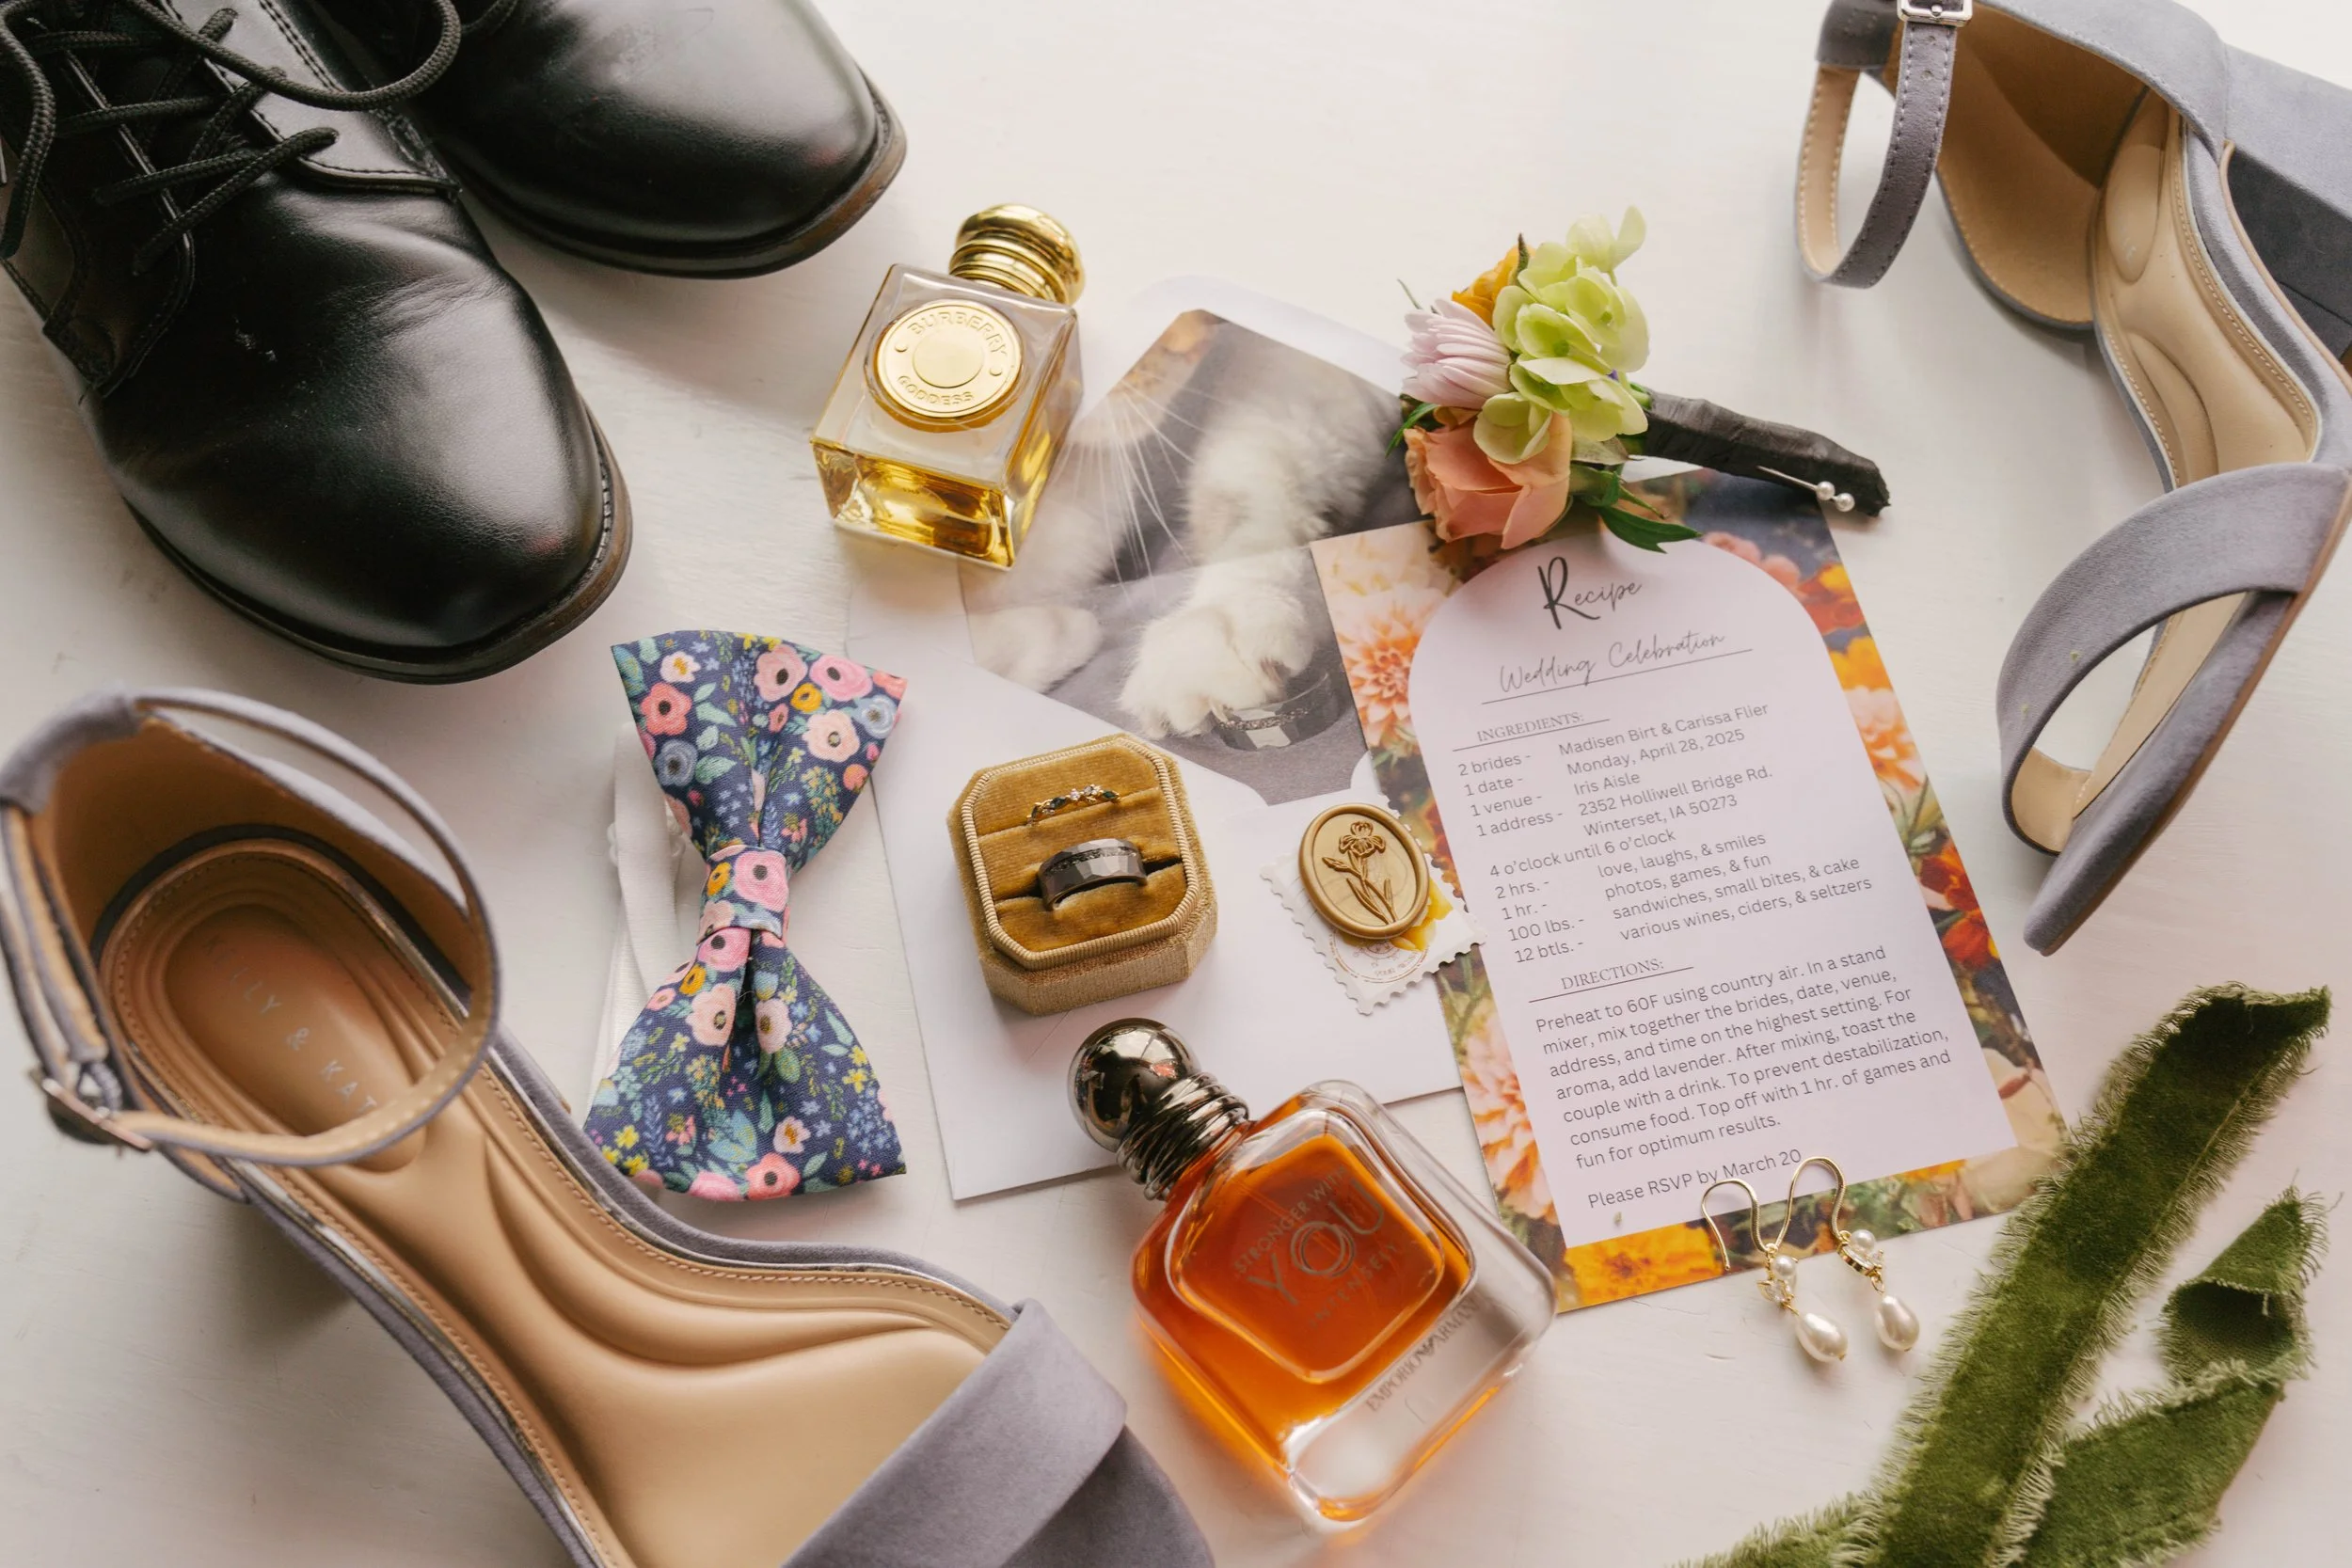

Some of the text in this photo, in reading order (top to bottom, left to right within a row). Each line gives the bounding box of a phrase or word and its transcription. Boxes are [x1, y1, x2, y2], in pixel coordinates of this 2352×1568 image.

[906, 310, 1009, 356] BURBERRY
[896, 374, 976, 406] GODDESS
[1536, 556, 1642, 630] Recipe
[1499, 629, 1725, 693] Wedding Celebration
[1457, 763, 1470, 777] 2
[1470, 754, 1522, 774] brides
[1558, 734, 1626, 755] Madisen
[1627, 726, 1659, 742] Birt
[1661, 722, 1674, 736] &
[1675, 712, 1734, 733] Carissa
[1733, 704, 1768, 721] Flier
[1476, 711, 1585, 742] INGREDIENTS:
[1463, 784, 1475, 798] 1
[1477, 777, 1515, 794] date
[1565, 754, 1637, 776] Monday,
[1640, 741, 1677, 762] April
[1677, 737, 1705, 753] 28,
[1704, 728, 1745, 748] 2025
[1470, 803, 1482, 817] 1
[1483, 795, 1534, 815] venue
[1573, 780, 1600, 796] Iris
[1602, 772, 1641, 791] Aisle
[1475, 823, 1488, 838] 1
[1489, 812, 1554, 835] address
[1578, 797, 1618, 816] 2352
[1619, 782, 1690, 808] Holliwell
[1691, 773, 1743, 793] Bridge
[1745, 765, 1773, 782] Rd.
[1582, 793, 1739, 837] Winterset, IA 50273
[1489, 864, 1501, 878] 4
[1564, 843, 1603, 863] until
[1603, 840, 1616, 855] 6
[1494, 885, 1507, 900] 2
[1508, 881, 1541, 896] hrs.
[1597, 862, 1639, 879] love,
[1639, 848, 1698, 870] laughs,
[1700, 843, 1714, 857] &
[1714, 833, 1767, 854] smiles
[1501, 906, 1514, 921] 1
[1514, 903, 1539, 918] hr.
[1604, 878, 1668, 902] photos,
[1669, 864, 1727, 889] games,
[1728, 859, 1742, 873] &
[1742, 854, 1772, 870] fun
[1506, 923, 1542, 942] 100
[1544, 919, 1576, 934] lbs.
[1612, 890, 1712, 920] sandwiches,
[1713, 877, 1759, 899] small
[1759, 870, 1806, 889] bites,
[1807, 864, 1821, 879] &
[1822, 858, 1861, 876] cake
[1514, 946, 1535, 964] 12
[1535, 941, 1575, 958] btls.
[1619, 919, 1681, 941] various
[1682, 908, 1736, 928] wines,
[1737, 895, 1793, 917] ciders,
[1794, 890, 1808, 905] &
[1808, 879, 1873, 901] seltzers
[1534, 1007, 1603, 1034] Preheat
[1603, 1005, 1624, 1019] to
[1662, 986, 1709, 1006] using
[1709, 972, 1774, 996] country
[1777, 964, 1805, 982] air.
[1805, 961, 1824, 975] In
[1826, 958, 1839, 971] a
[1838, 944, 1887, 968] stand
[1560, 958, 1664, 990] DIRECTIONS:
[1542, 970, 1897, 1055] mixer, mix together the brides, date, venue,
[1549, 988, 1912, 1078] address, and time on the highest setting. For
[1555, 1011, 1917, 1101] aroma, add lavender. After mixing, toast the
[1563, 1029, 1949, 1124] couple with a drink. To prevent destabilization,
[1569, 1048, 1952, 1147] consume food. Top off with 1 hr. of games and
[1575, 1115, 1782, 1170] fun for optimum results.
[1587, 1148, 1803, 1210] Please RSVP by March 20
[1234, 1200, 1311, 1275] STRONGER
[1247, 1179, 1385, 1307] YOU
[1366, 1349, 1422, 1411] EMPORIO
